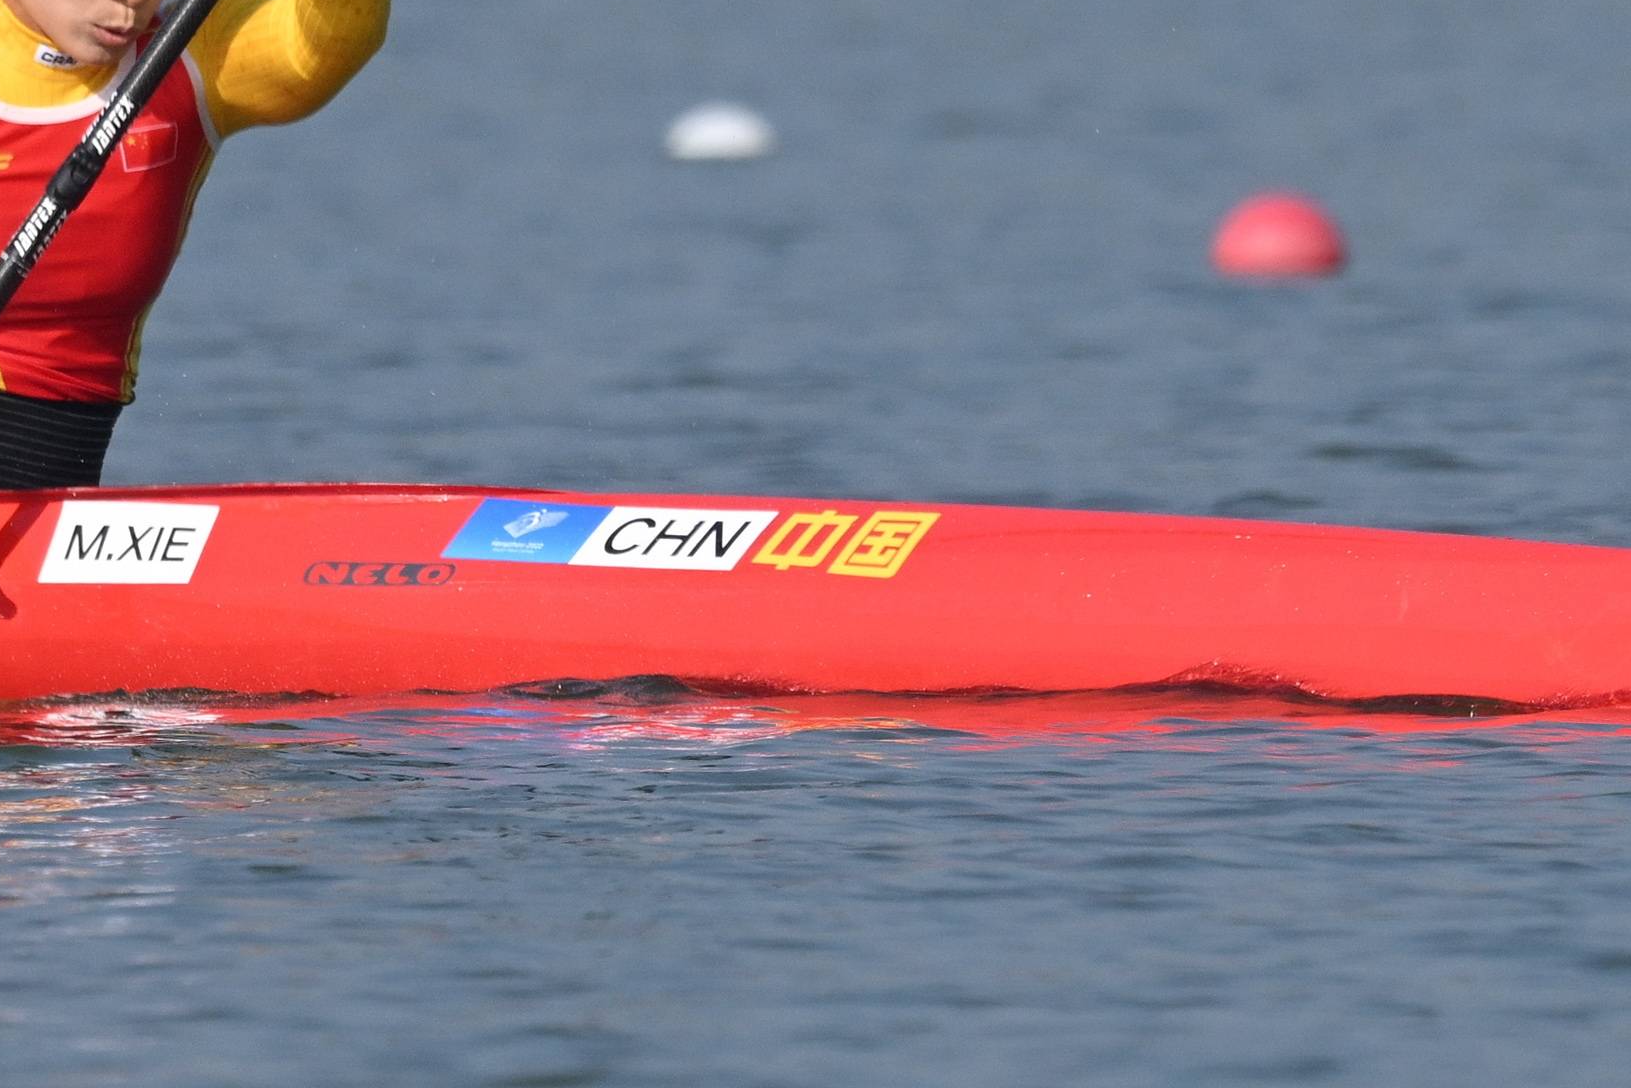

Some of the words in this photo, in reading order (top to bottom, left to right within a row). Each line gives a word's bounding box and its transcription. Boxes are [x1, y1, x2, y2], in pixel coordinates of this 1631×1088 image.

[64, 524, 197, 562] M.XIE
[604, 517, 752, 558] CHN
[752, 509, 941, 579] 中国
[306, 562, 453, 585] NELO
